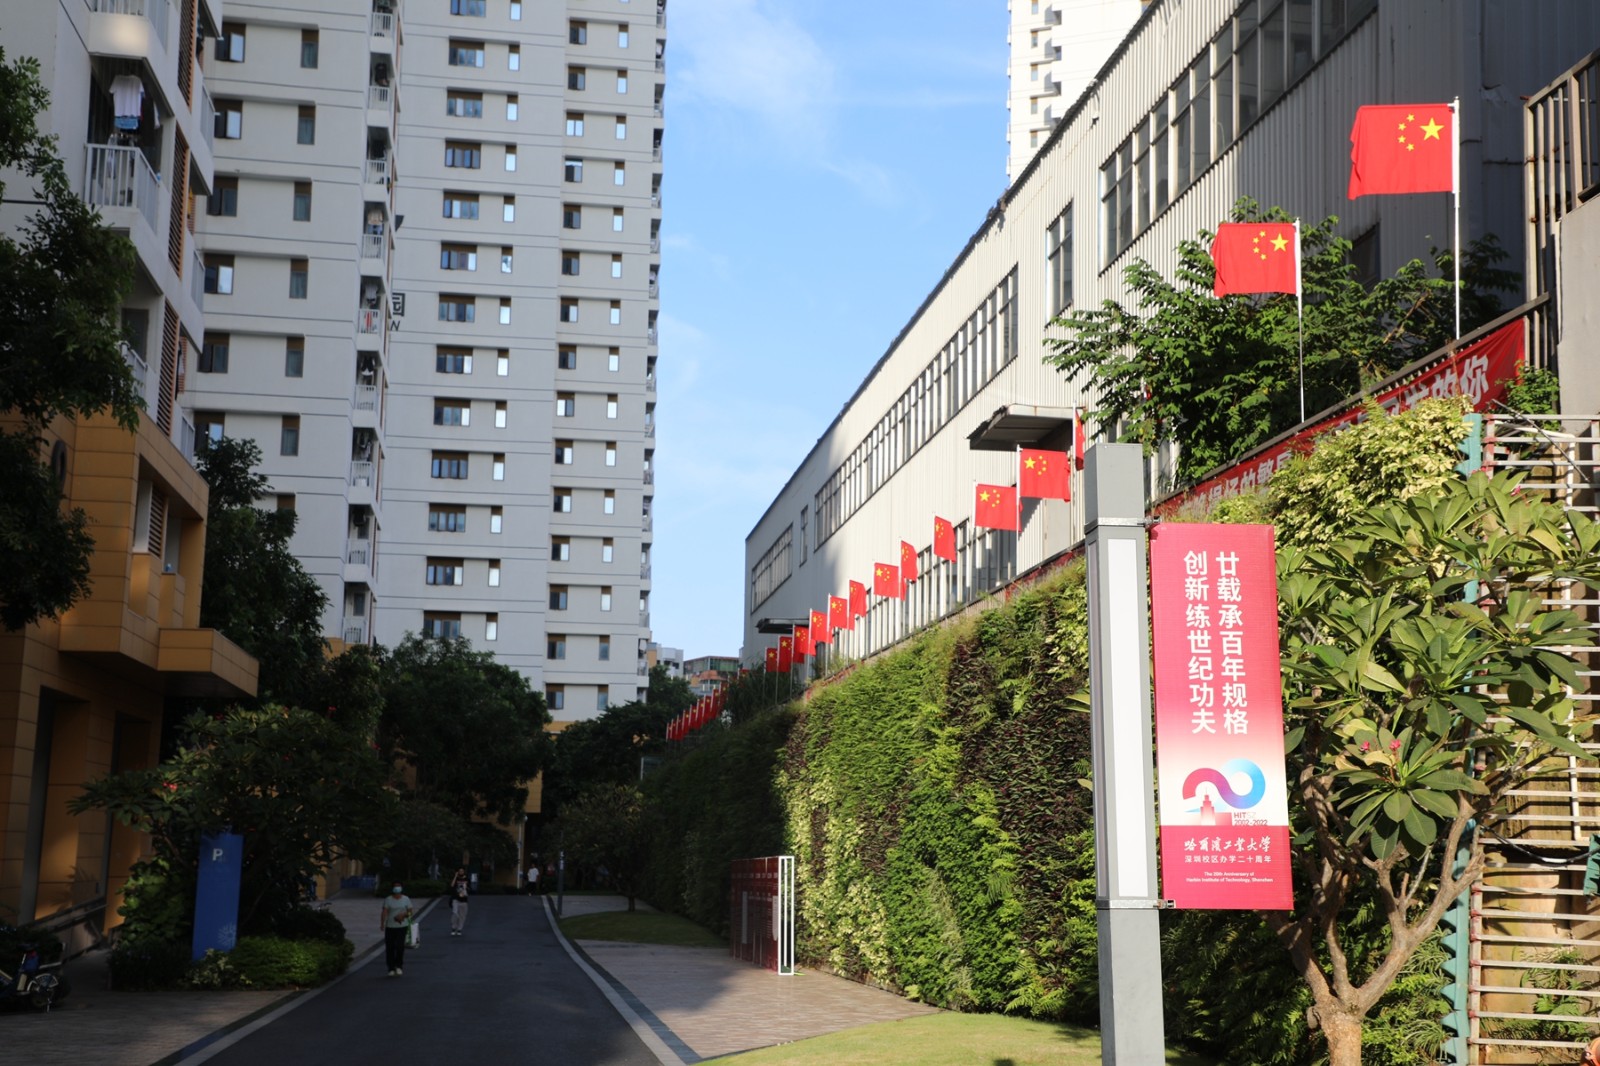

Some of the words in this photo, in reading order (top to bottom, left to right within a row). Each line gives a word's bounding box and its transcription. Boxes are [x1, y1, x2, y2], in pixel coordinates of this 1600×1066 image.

[1183, 550, 1216, 734] 创新练世纪功夫
[1215, 551, 1249, 735] 廿载承百年规格
[212, 848, 223, 861] P
[1185, 855, 1272, 864] 深圳校区办学二十周年
